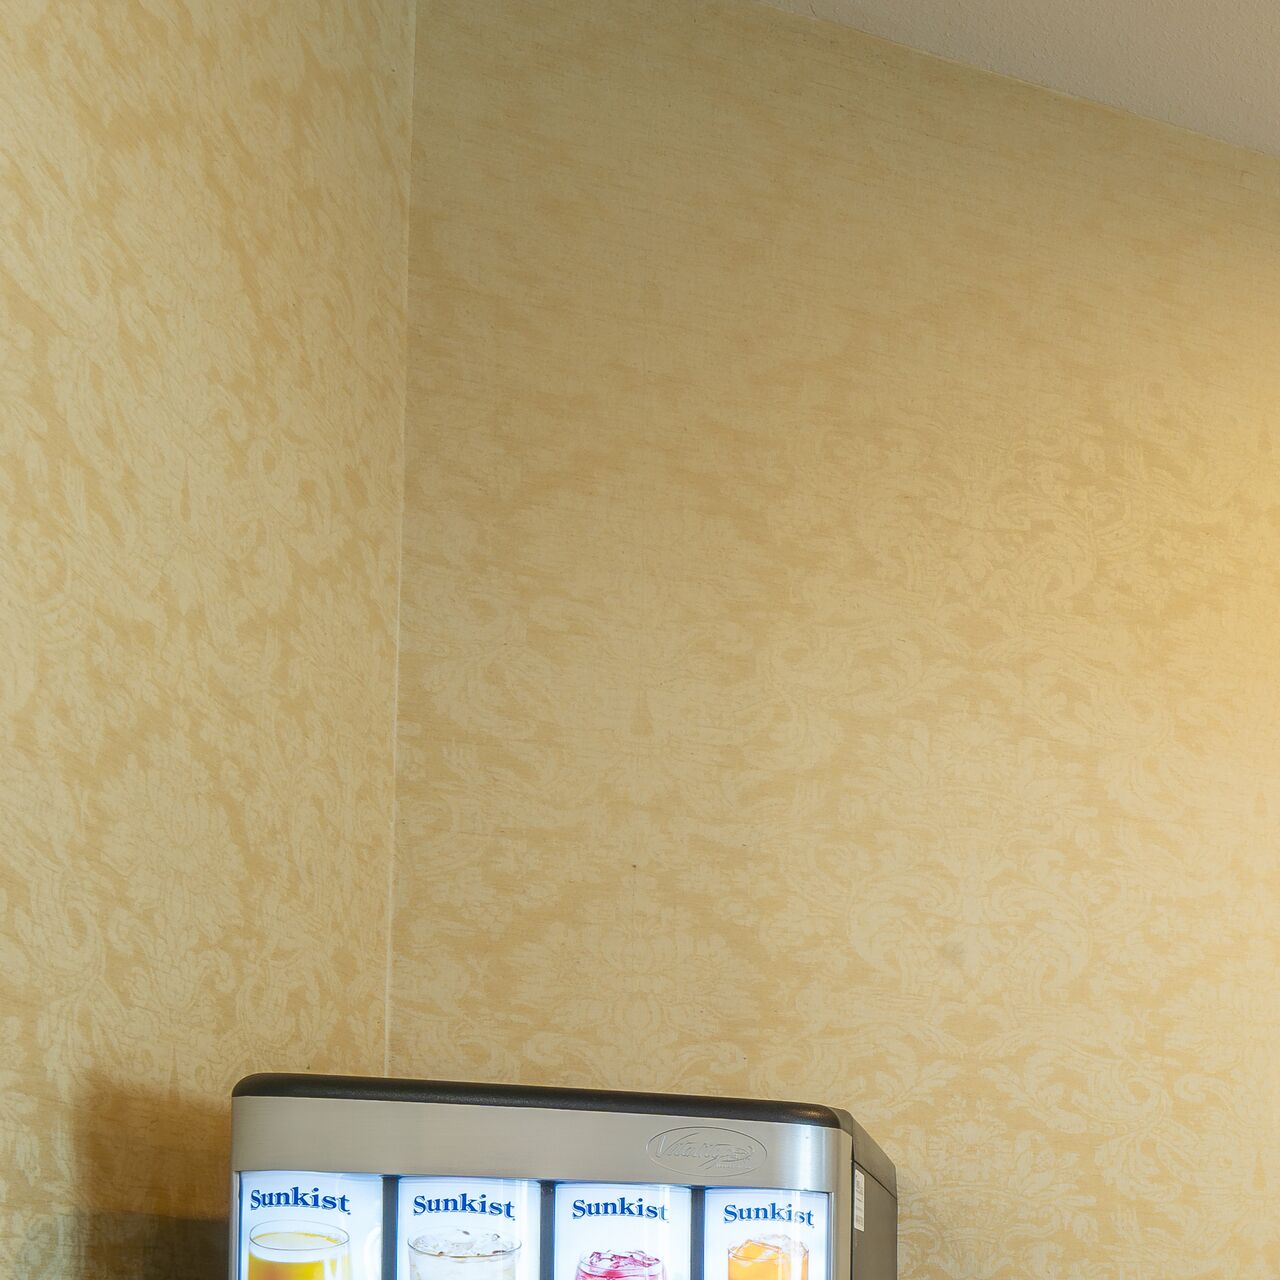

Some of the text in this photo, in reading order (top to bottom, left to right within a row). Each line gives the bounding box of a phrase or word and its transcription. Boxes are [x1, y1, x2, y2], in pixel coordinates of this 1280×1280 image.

[250, 1186, 350, 1213] Sunkist
[413, 1193, 515, 1219] Sunkist
[572, 1197, 669, 1221] Sunkist
[723, 1203, 814, 1226] Sunkist
